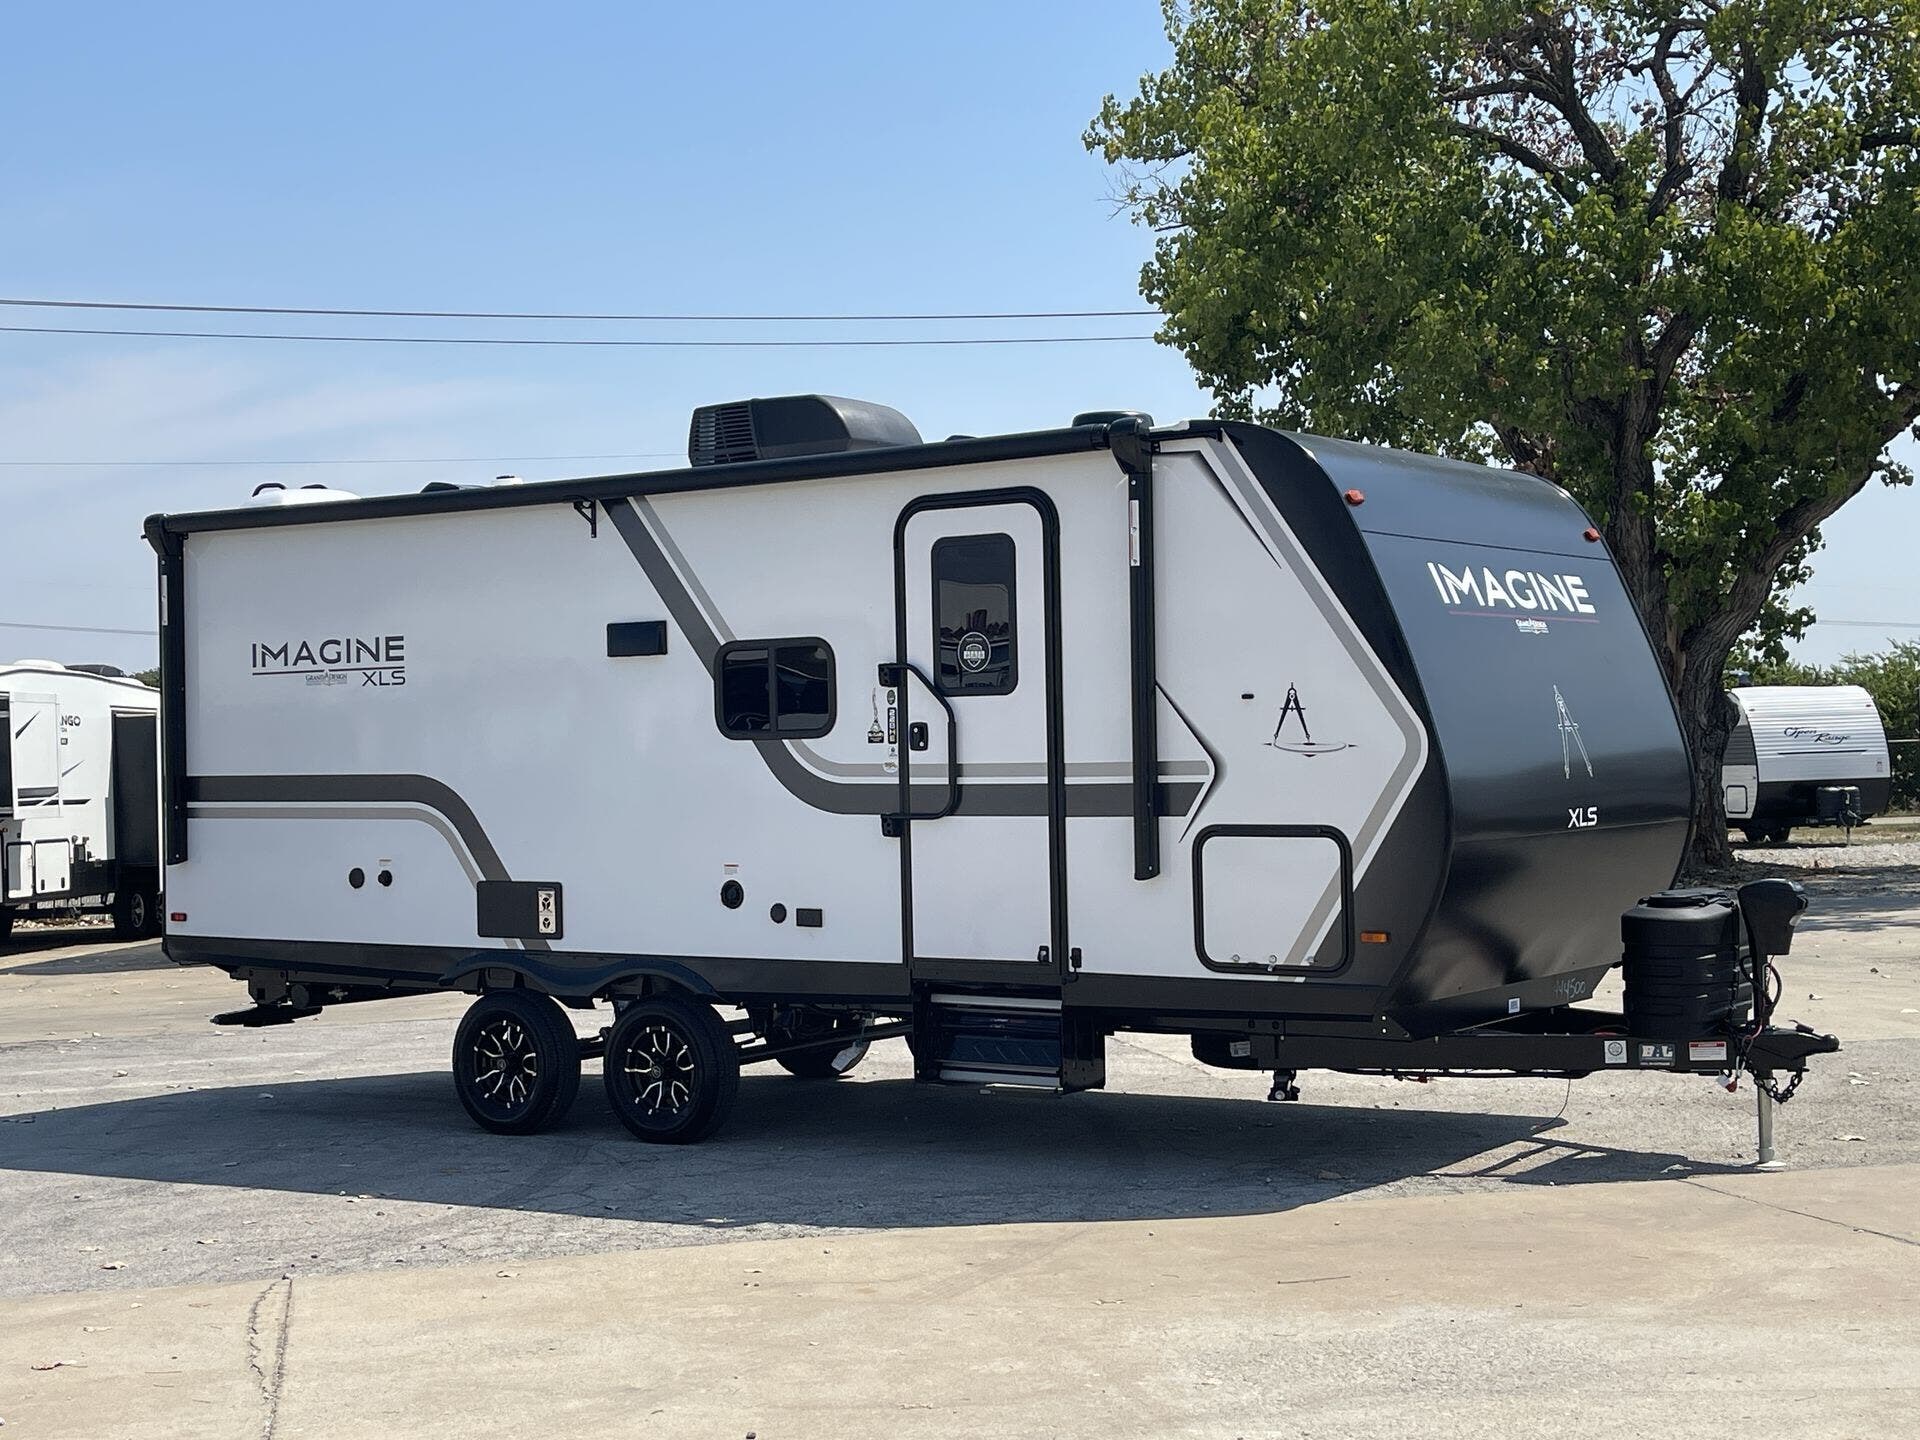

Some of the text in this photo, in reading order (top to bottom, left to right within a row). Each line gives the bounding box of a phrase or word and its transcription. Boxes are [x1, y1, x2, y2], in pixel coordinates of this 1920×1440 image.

[1427, 562, 1596, 613] IMAGINE
[252, 636, 404, 668] IMAGINE
[362, 670, 405, 686] XLS
[60, 715, 81, 726] NGO
[1784, 727, 1849, 745] Open Range
[1567, 806, 1598, 828] XLS
